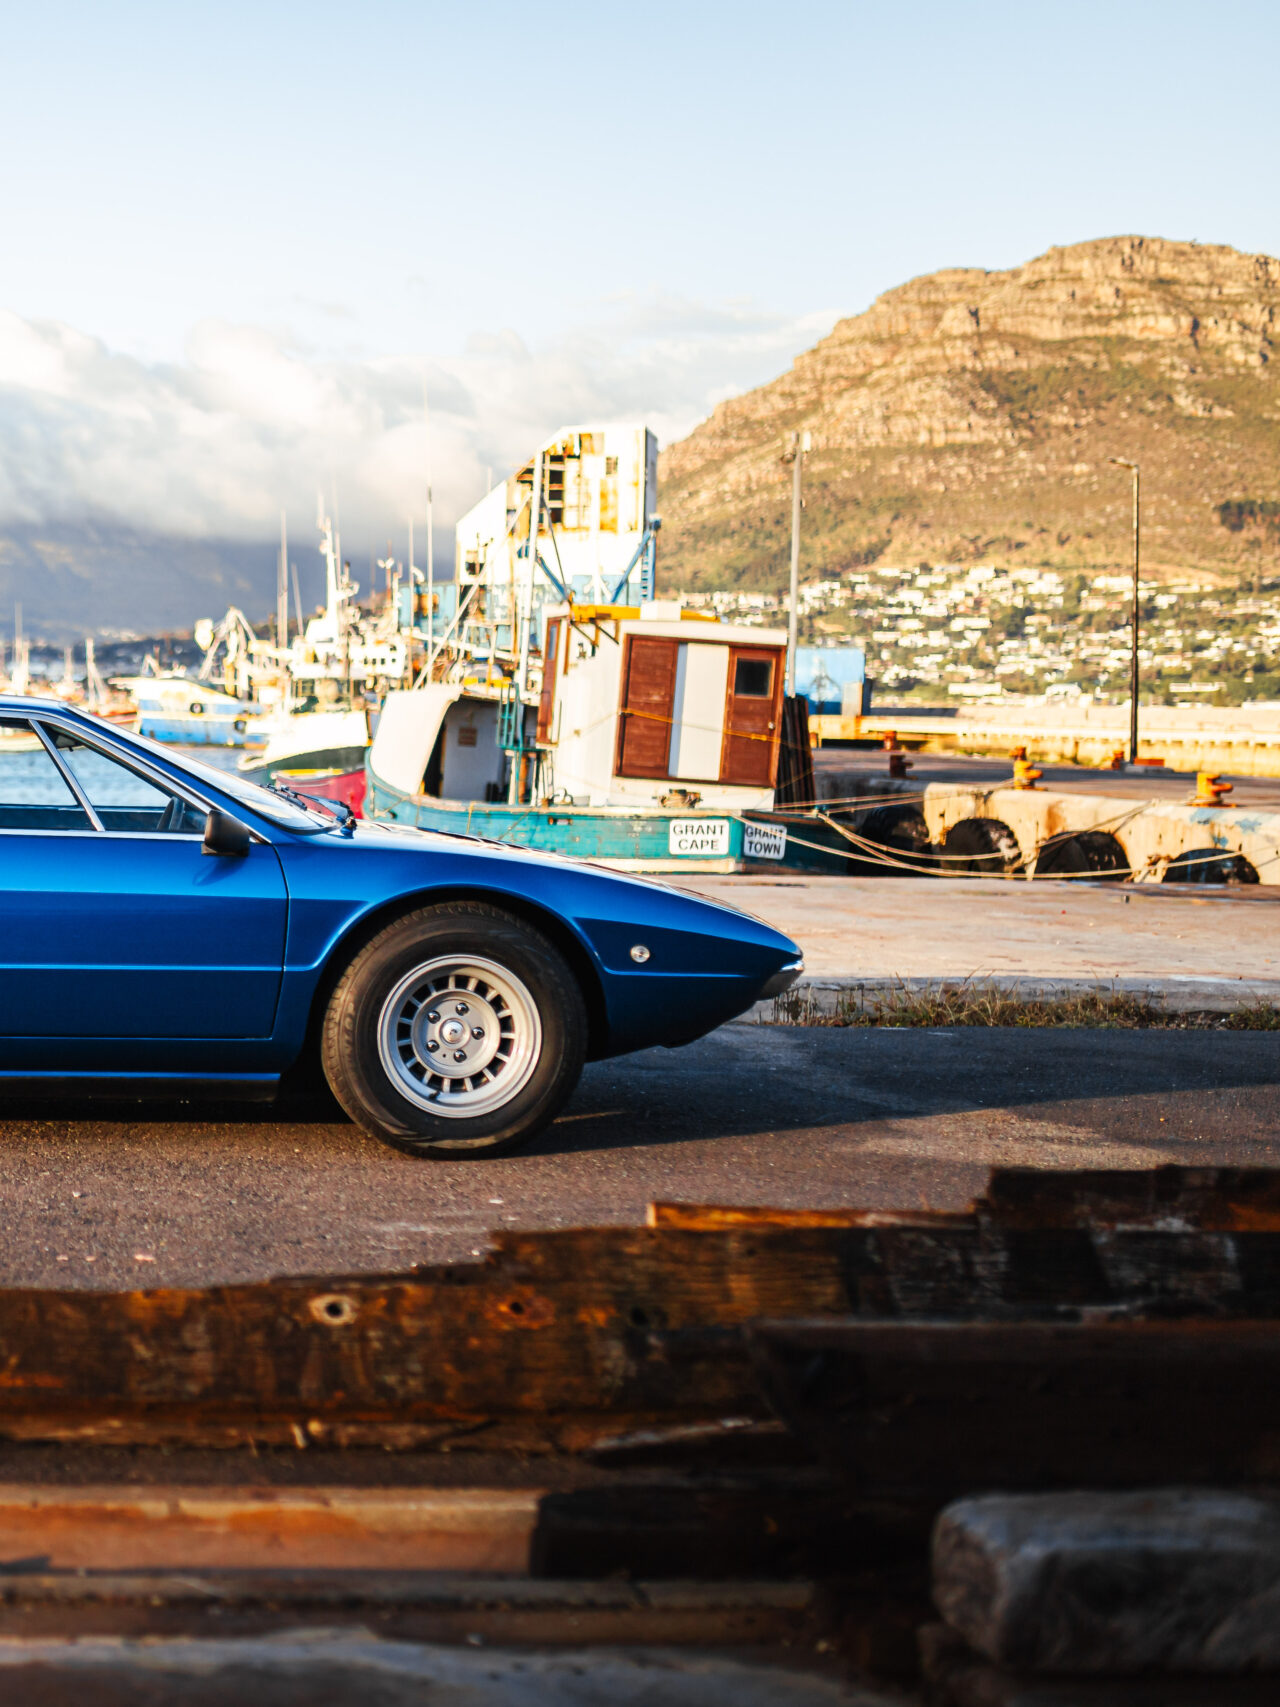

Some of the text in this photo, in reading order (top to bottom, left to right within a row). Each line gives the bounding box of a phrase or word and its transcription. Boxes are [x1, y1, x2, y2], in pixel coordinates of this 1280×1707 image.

[673, 824, 725, 835] GRANT
[678, 839, 719, 850] CAPE
[748, 841, 781, 855] TOWN
